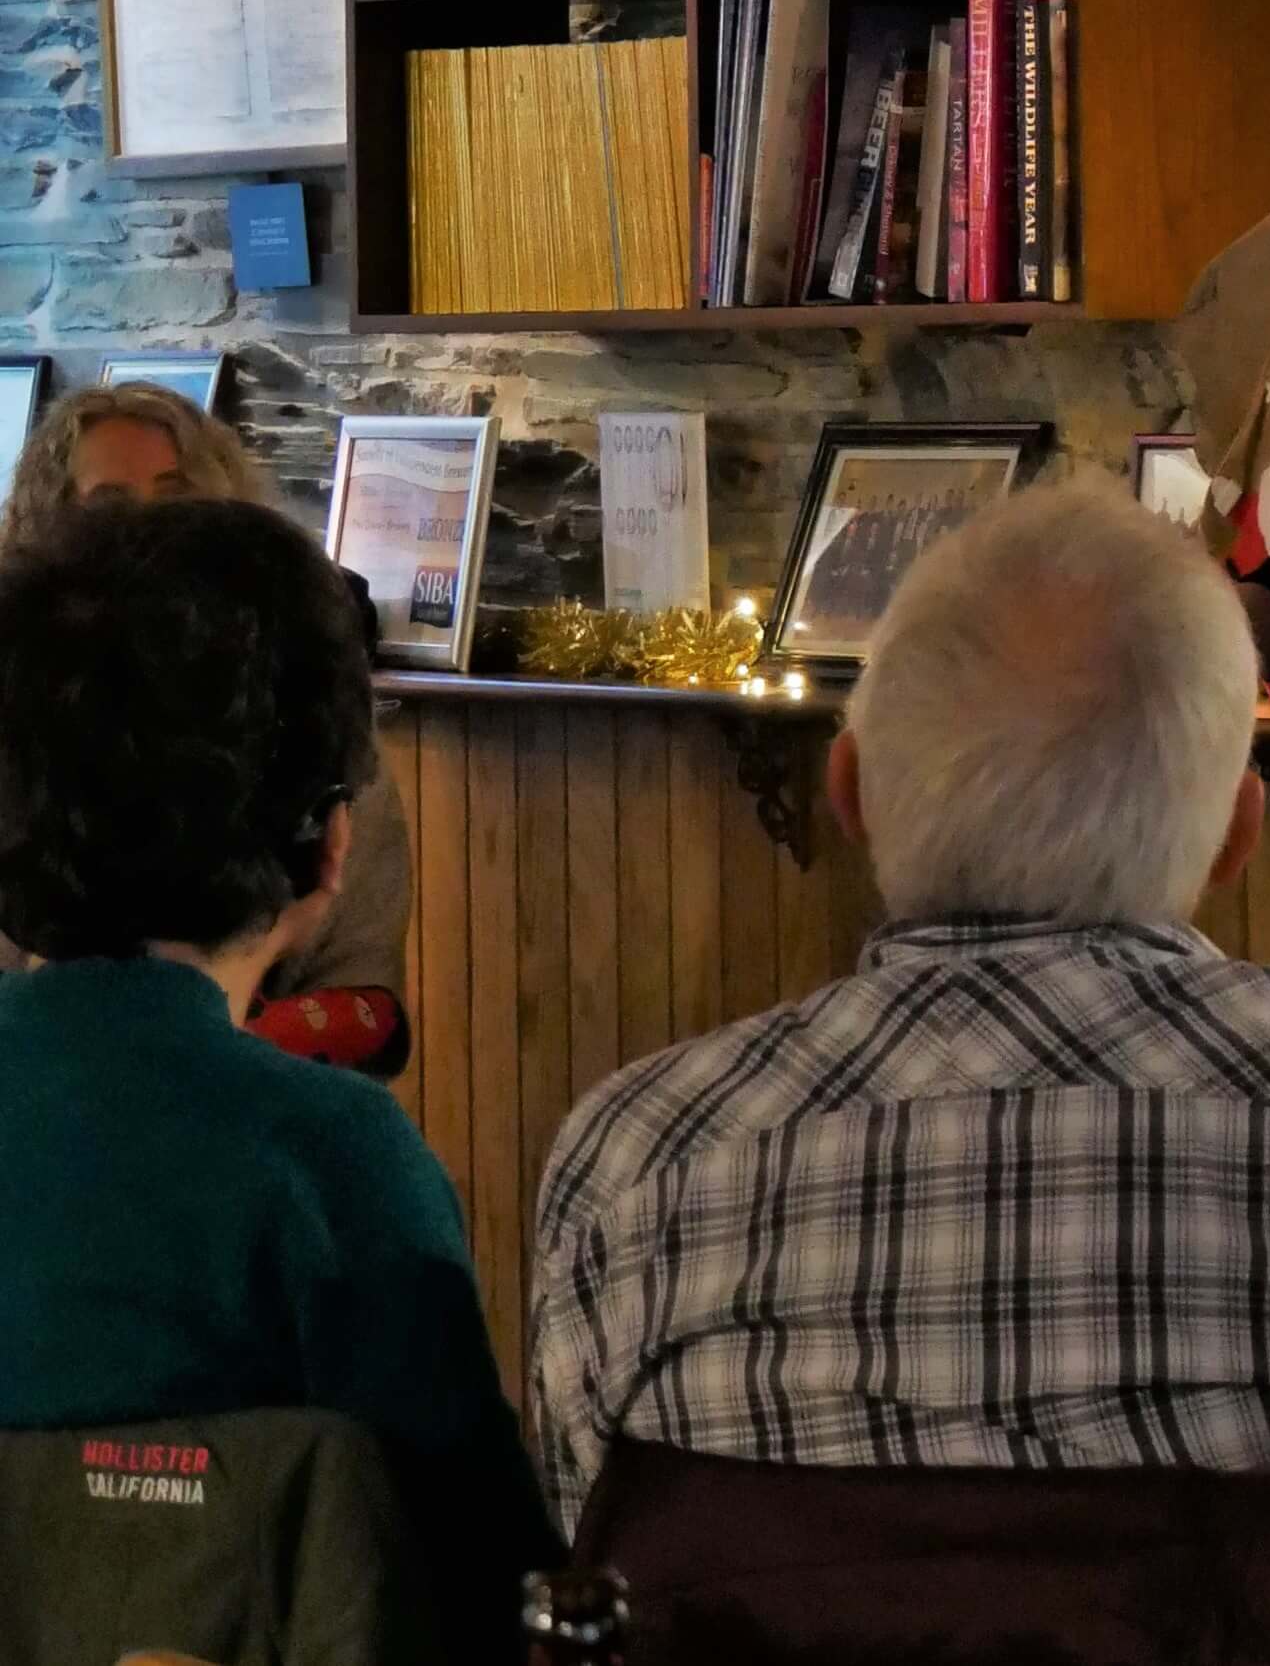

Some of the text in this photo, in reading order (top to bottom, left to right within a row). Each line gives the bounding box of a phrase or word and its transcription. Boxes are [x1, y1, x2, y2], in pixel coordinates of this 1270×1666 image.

[860, 88, 892, 169] BEER
[951, 98, 964, 171] TARTAN
[1023, 6, 1037, 244] THE WILDLIFE YEAR
[415, 570, 454, 605] SIBA
[82, 1440, 209, 1475] HOLLISTER
[86, 1472, 205, 1505] CALIFORNIA
